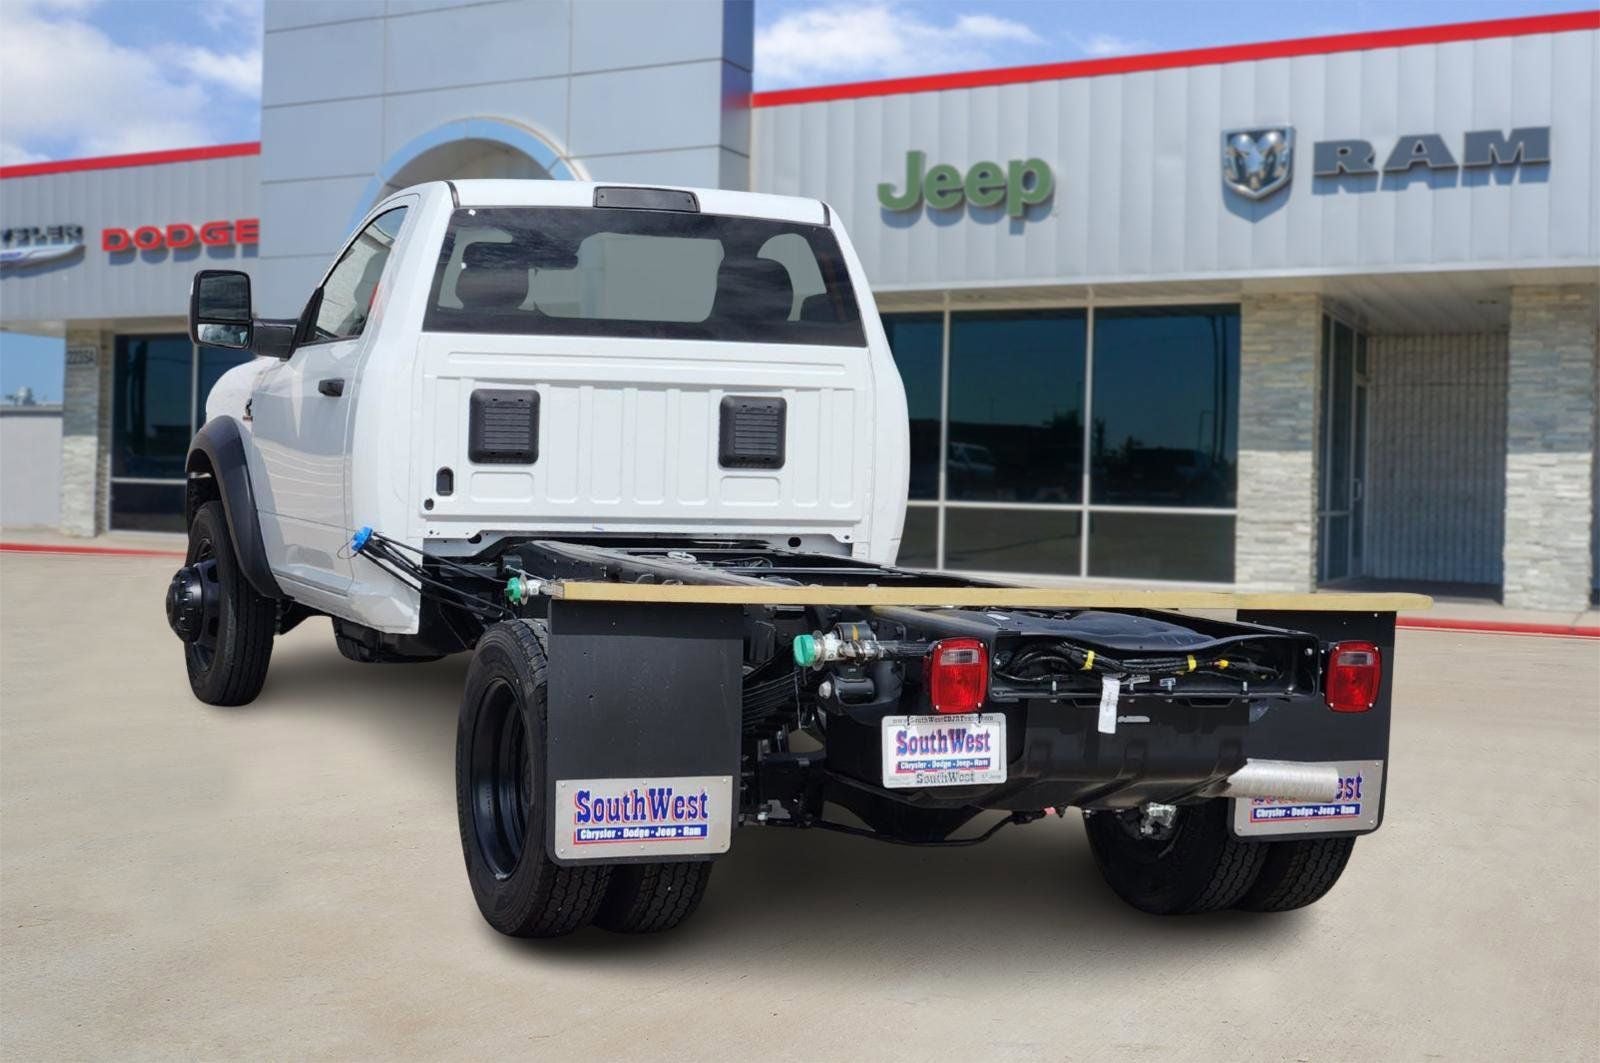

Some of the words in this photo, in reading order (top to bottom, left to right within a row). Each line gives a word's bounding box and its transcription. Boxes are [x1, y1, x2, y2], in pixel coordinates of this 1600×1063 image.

[1313, 127, 1550, 177] RAM
[877, 150, 1053, 217] Jeep
[101, 218, 260, 252] DODGE
[896, 728, 991, 756] SouthWest
[900, 761, 926, 770] Chrysler
[931, 760, 951, 769] Dodge
[956, 759, 970, 768] Jeep
[974, 758, 988, 767] Ram
[916, 771, 975, 784] SouthWest
[575, 788, 708, 824] SouthWest
[1256, 808, 1286, 819] Chrysler
[1291, 807, 1314, 817] Dodge
[1318, 806, 1335, 816] Jeep
[1341, 805, 1356, 814] Ram
[580, 828, 616, 840] Chrysler
[623, 826, 649, 839] Dodge
[655, 826, 676, 838] Jeep
[683, 825, 701, 836] Ram
